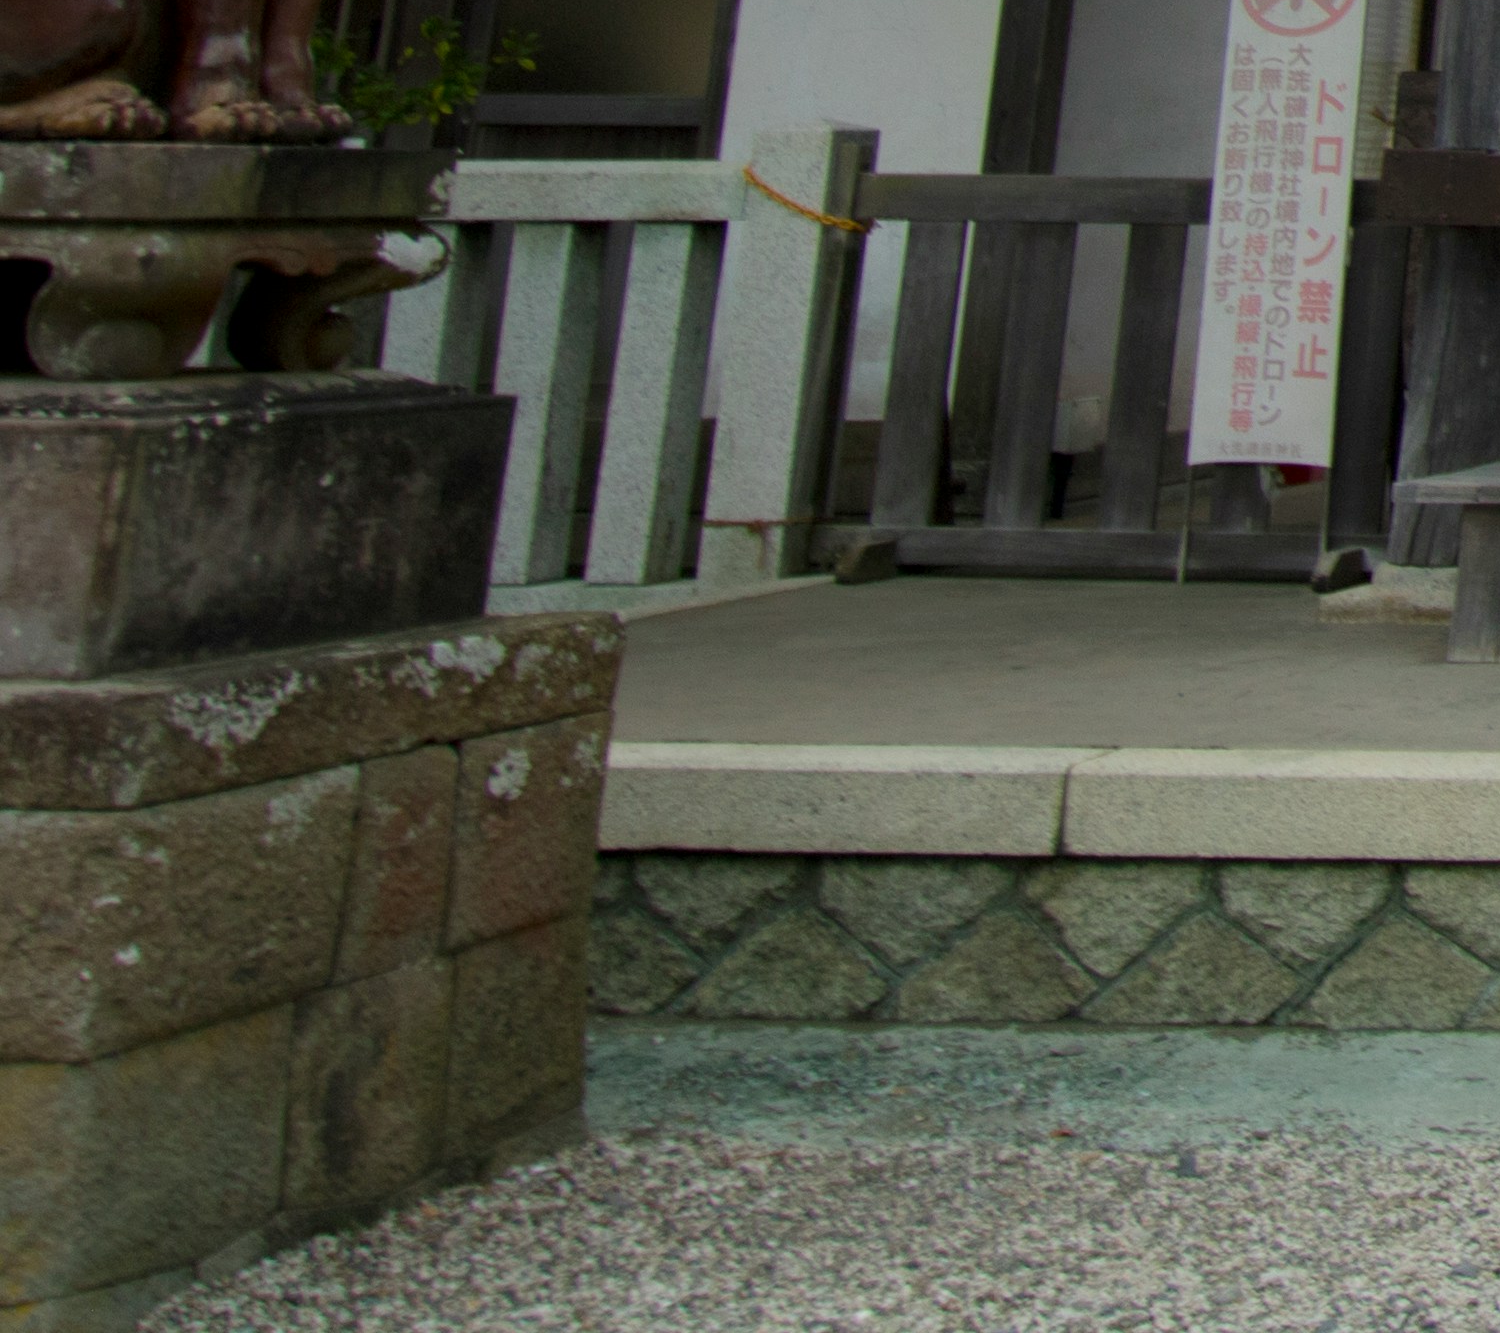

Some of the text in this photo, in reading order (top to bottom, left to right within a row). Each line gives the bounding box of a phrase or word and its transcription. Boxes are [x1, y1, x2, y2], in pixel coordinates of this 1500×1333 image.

[1213, 42, 1258, 315] は固くお断り致します。
[1257, 43, 1313, 427] 大洗磯前神社境内地でのドローン
[1292, 78, 1347, 380] ドローン禁止
